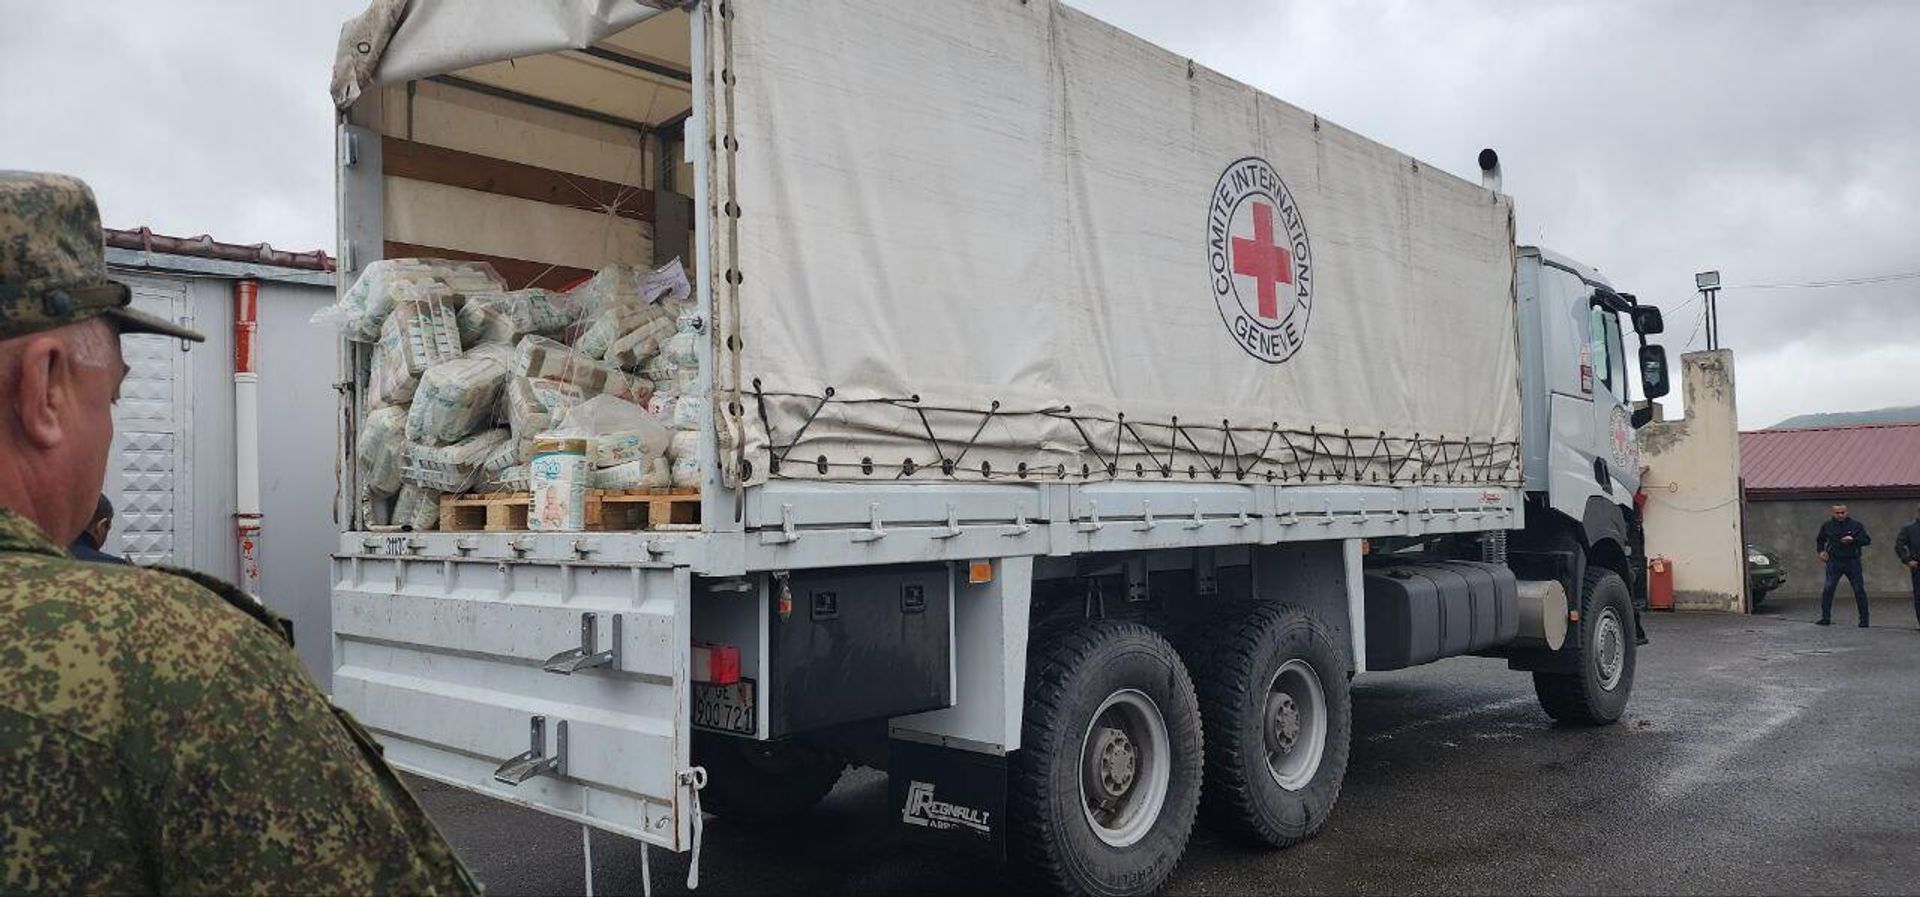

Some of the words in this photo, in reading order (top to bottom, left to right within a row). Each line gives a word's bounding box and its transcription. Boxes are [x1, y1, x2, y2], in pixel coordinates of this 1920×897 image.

[1210, 183, 1234, 296] COMITE
[1234, 315, 1299, 357] GENEVE
[910, 788, 990, 825] REGNAULT
